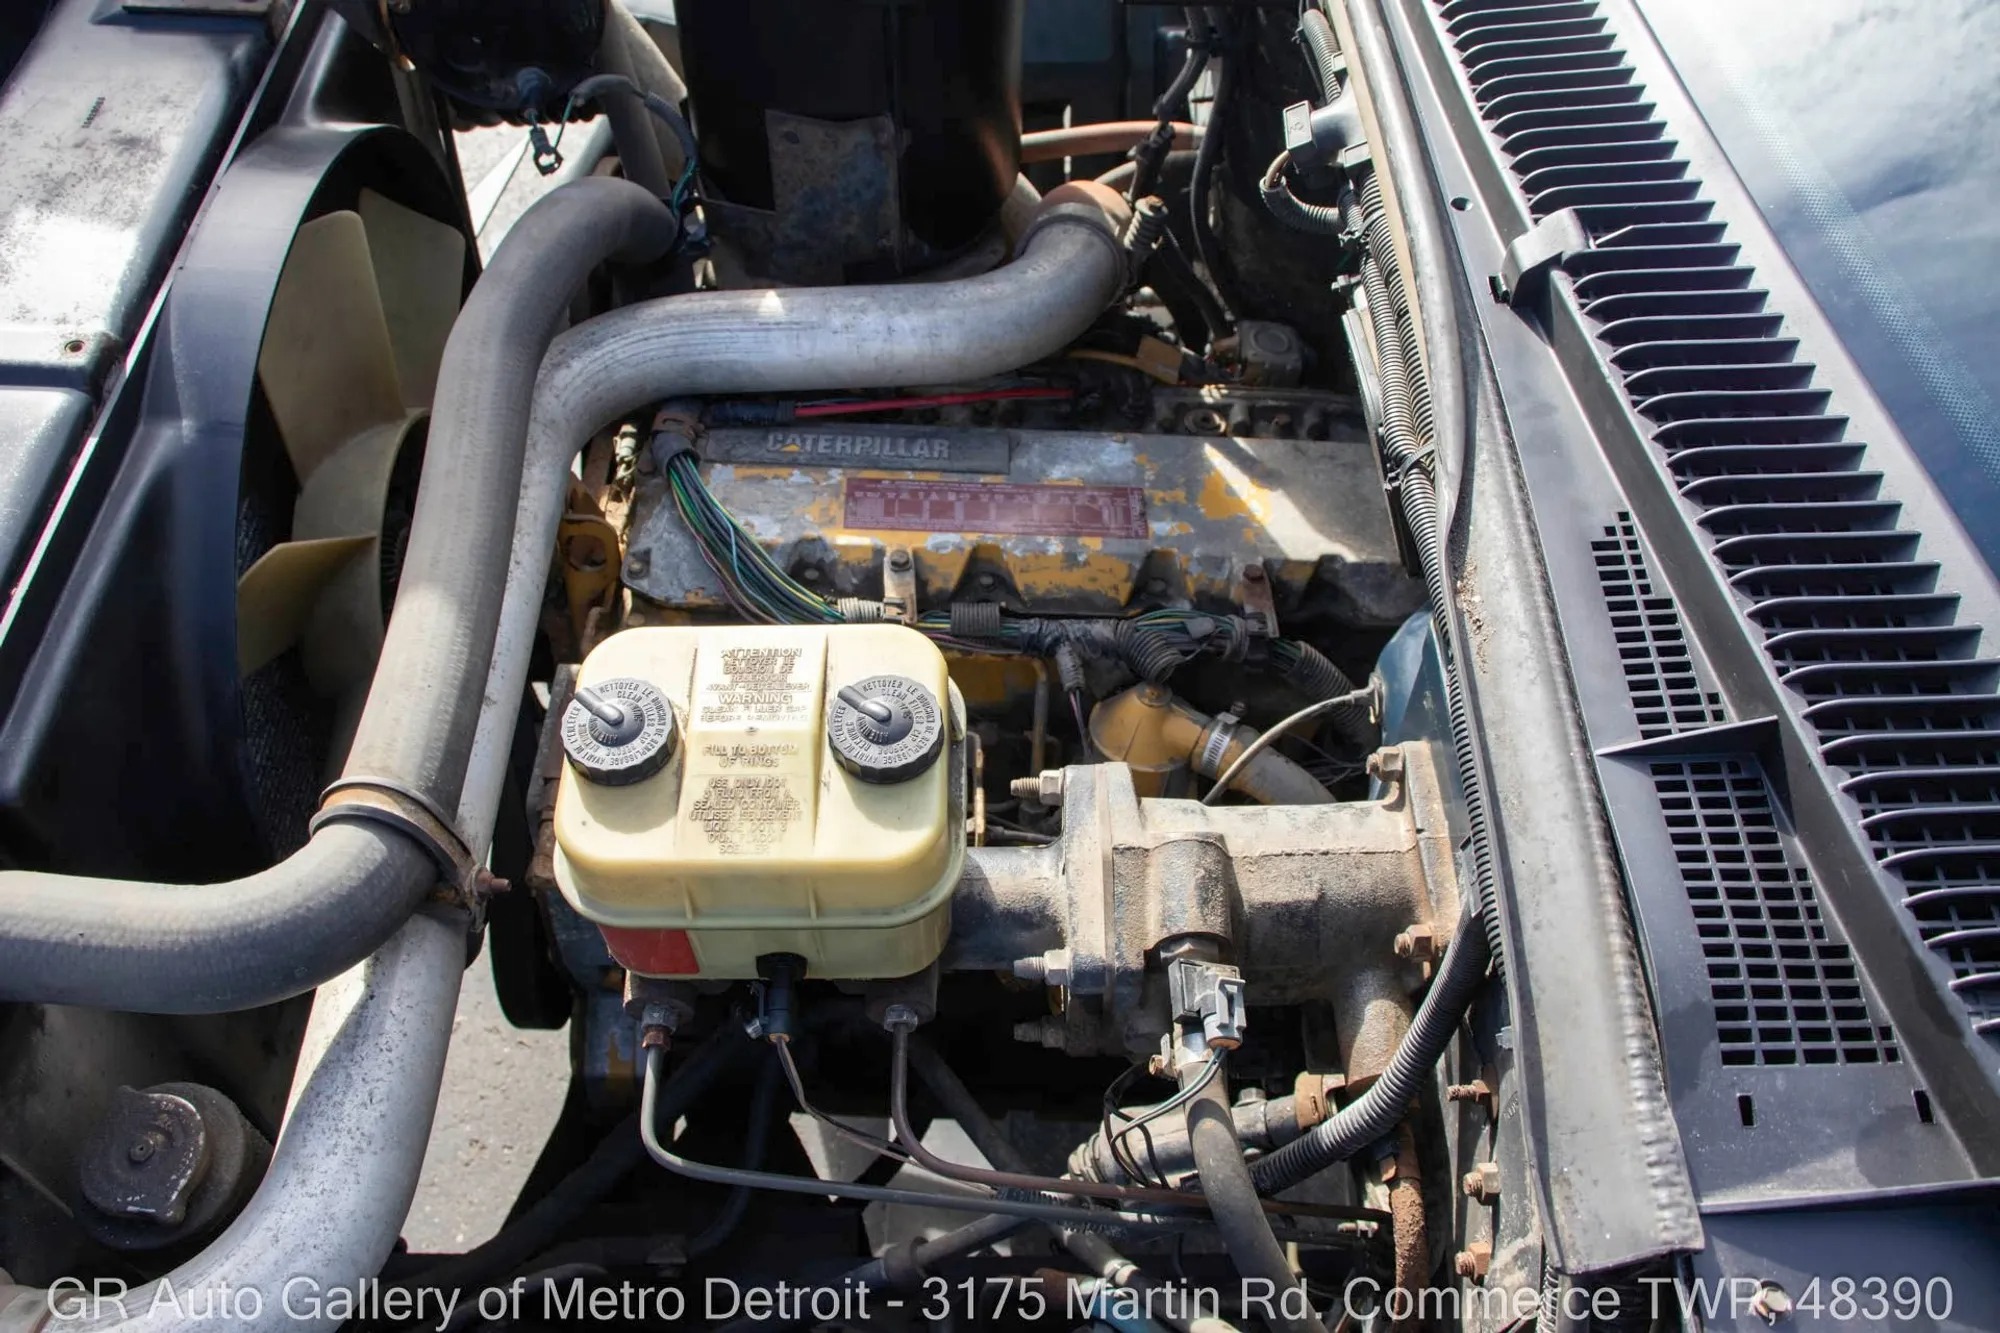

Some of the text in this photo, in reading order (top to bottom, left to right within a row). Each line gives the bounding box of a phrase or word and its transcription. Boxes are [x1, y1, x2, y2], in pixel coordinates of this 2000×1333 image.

[766, 431, 949, 458] CATERPILLAR
[721, 648, 802, 658] ATTENTION
[718, 692, 793, 705] WARNING
